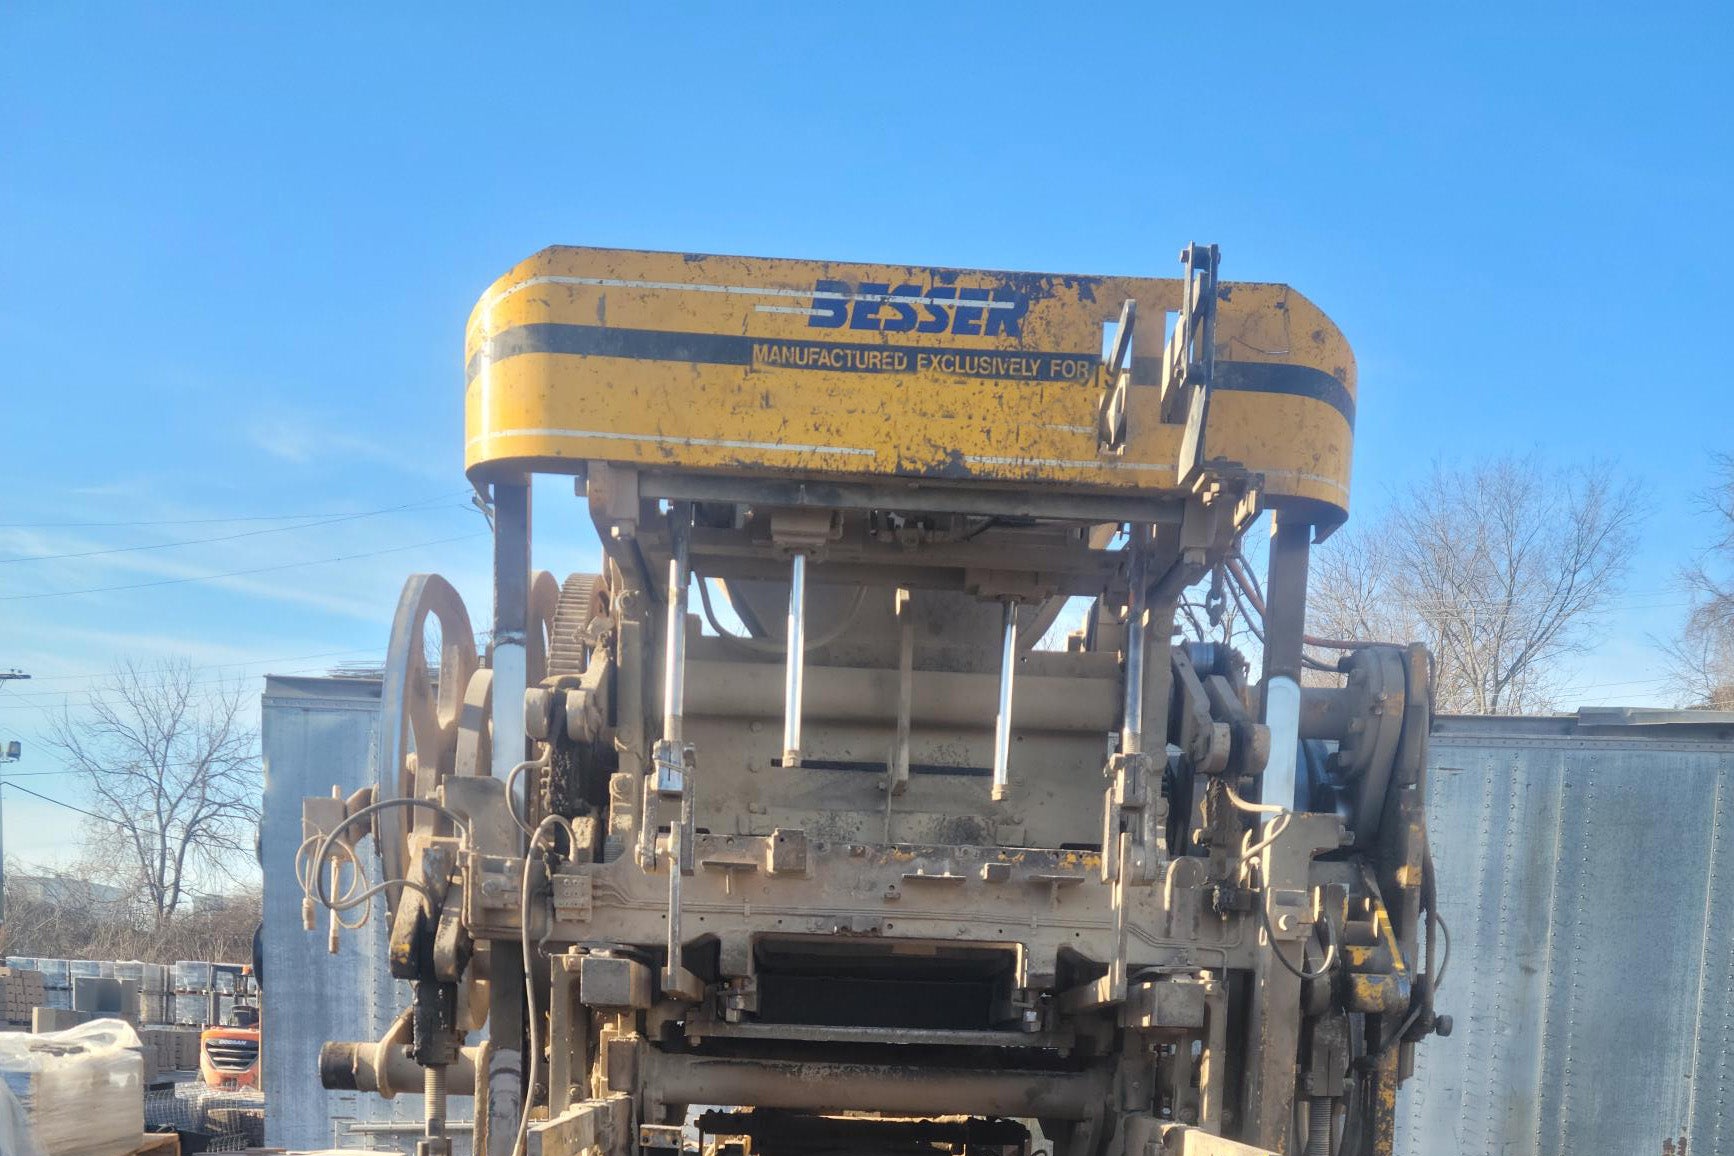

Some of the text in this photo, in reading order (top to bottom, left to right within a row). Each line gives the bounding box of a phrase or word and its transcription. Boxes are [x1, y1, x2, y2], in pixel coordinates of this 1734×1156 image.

[807, 279, 1030, 338] BESSER
[752, 342, 908, 371] MANUFACTURED
[916, 353, 1042, 377] EXCLUSIVELY
[1050, 359, 1089, 379] FOR
